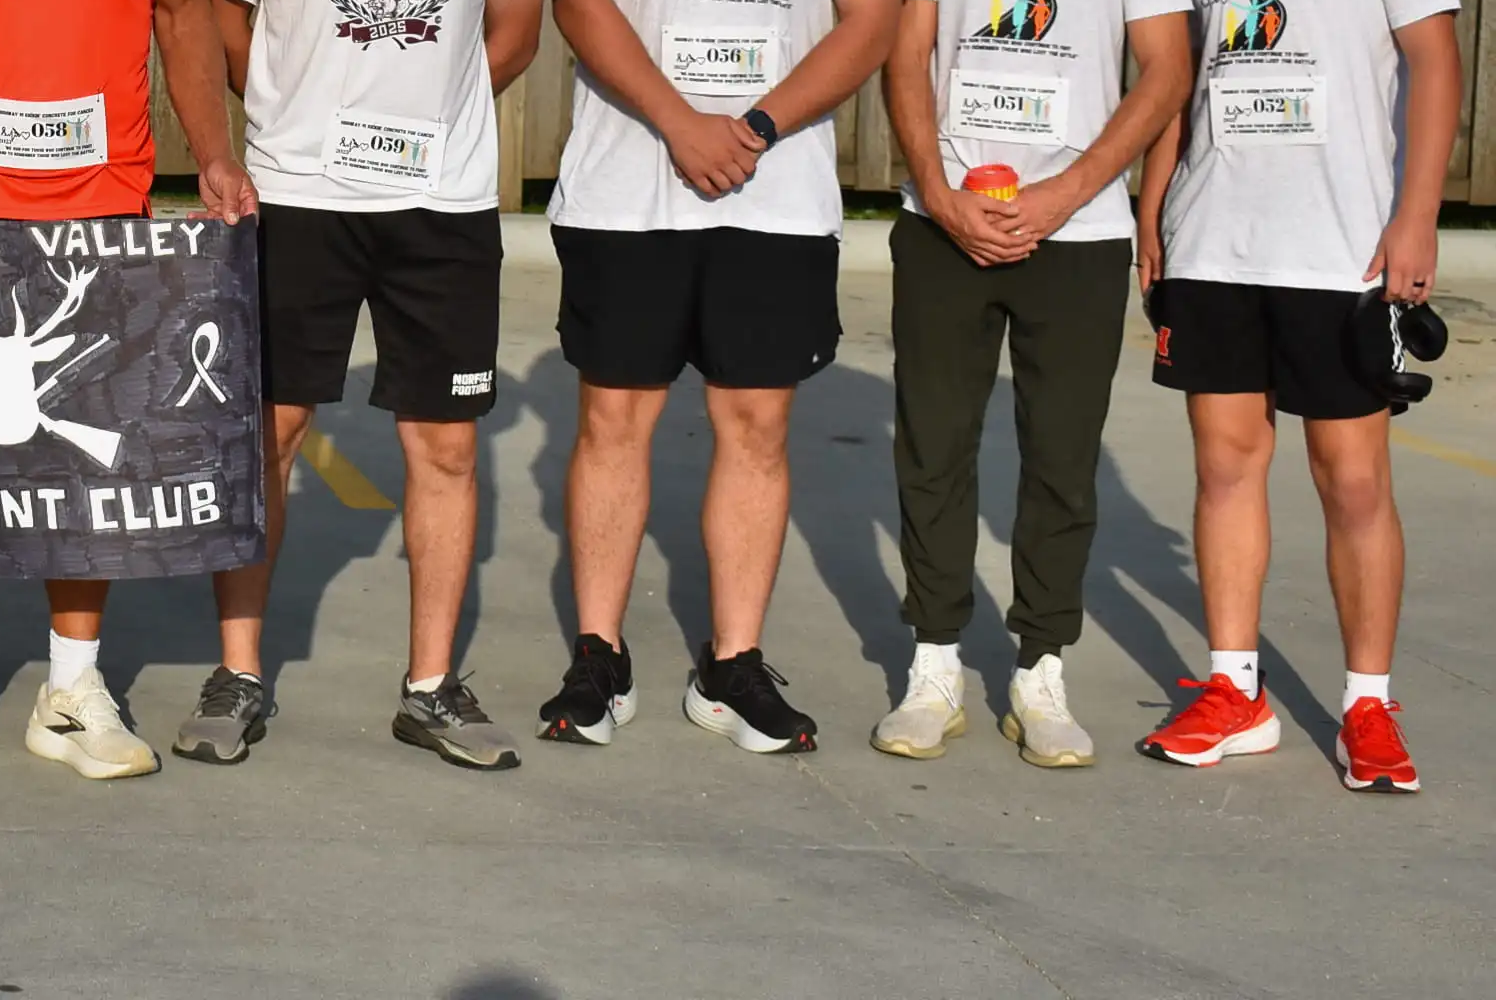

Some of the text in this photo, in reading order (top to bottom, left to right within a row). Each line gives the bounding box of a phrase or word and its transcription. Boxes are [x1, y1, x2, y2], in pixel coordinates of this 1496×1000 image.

[370, 21, 406, 38] 2025
[707, 48, 740, 63] 056
[994, 95, 1023, 111] 051
[1253, 98, 1285, 113] 052
[32, 122, 67, 137] 058
[371, 135, 405, 154] 059
[31, 222, 204, 256] VALLEY
[88, 481, 220, 530] CLUB
